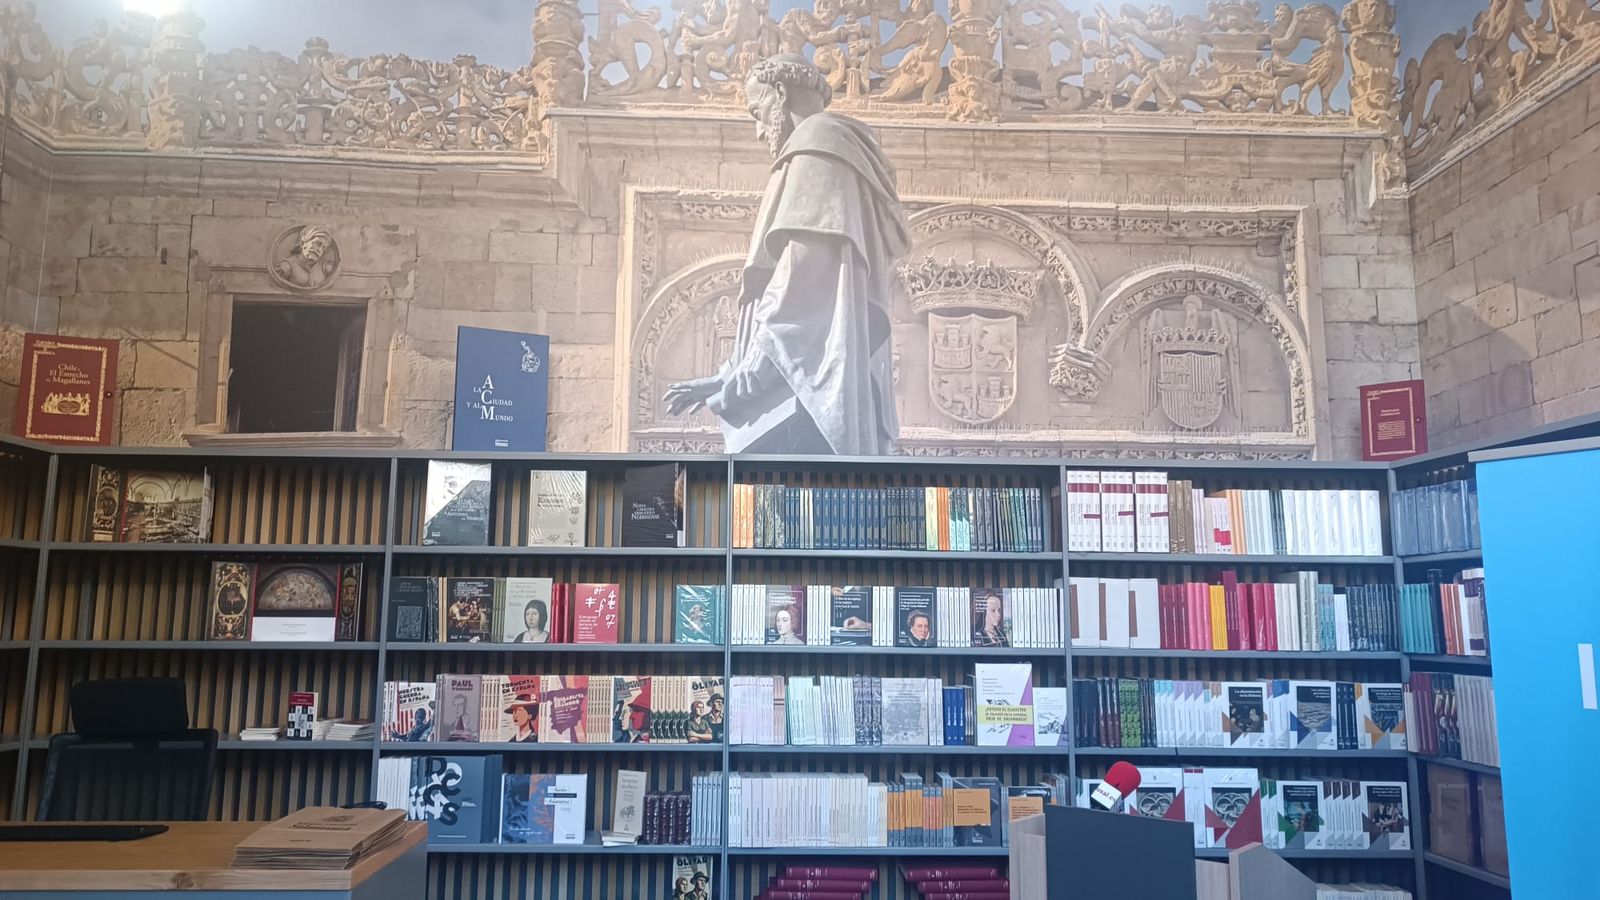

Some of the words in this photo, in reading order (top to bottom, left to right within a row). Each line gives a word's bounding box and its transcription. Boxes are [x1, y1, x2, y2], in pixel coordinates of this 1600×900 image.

[52, 377, 91, 385] Magallanes
[481, 374, 494, 389] A
[501, 680, 534, 688] TORMENTA
[512, 684, 535, 692] ESPAÑA
